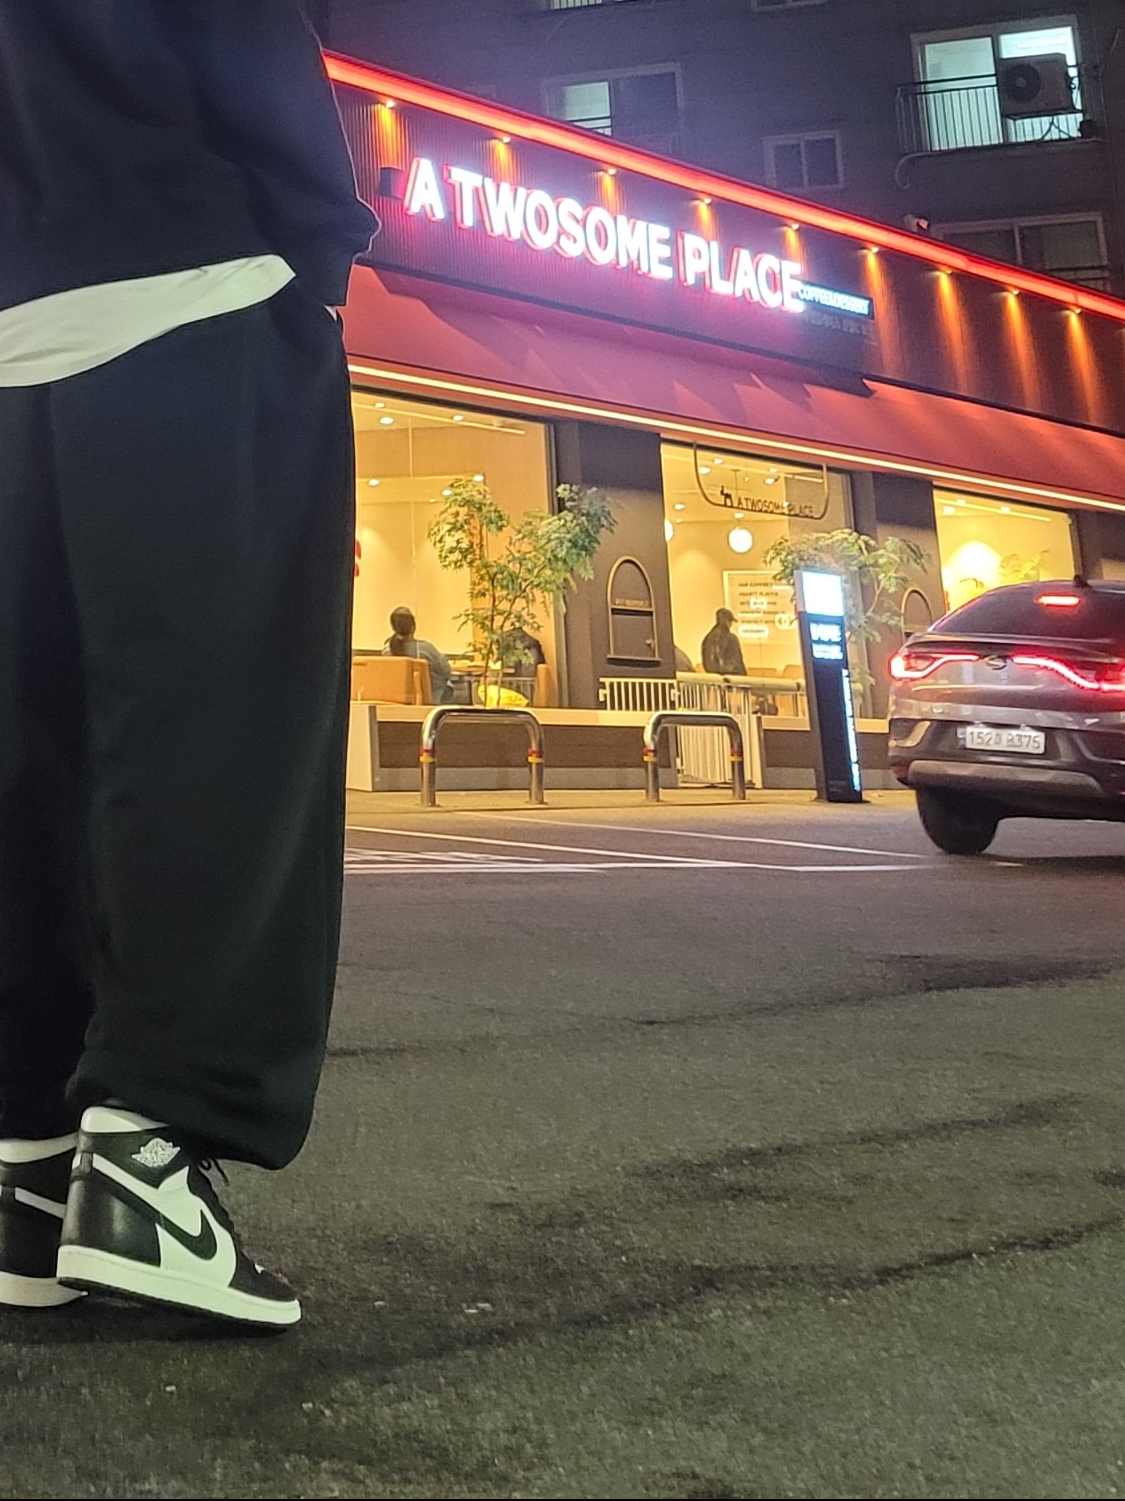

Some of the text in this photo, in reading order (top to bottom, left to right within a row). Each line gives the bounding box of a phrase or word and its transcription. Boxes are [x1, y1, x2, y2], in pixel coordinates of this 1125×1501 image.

[404, 157, 806, 313] A TWOSOME PLACE
